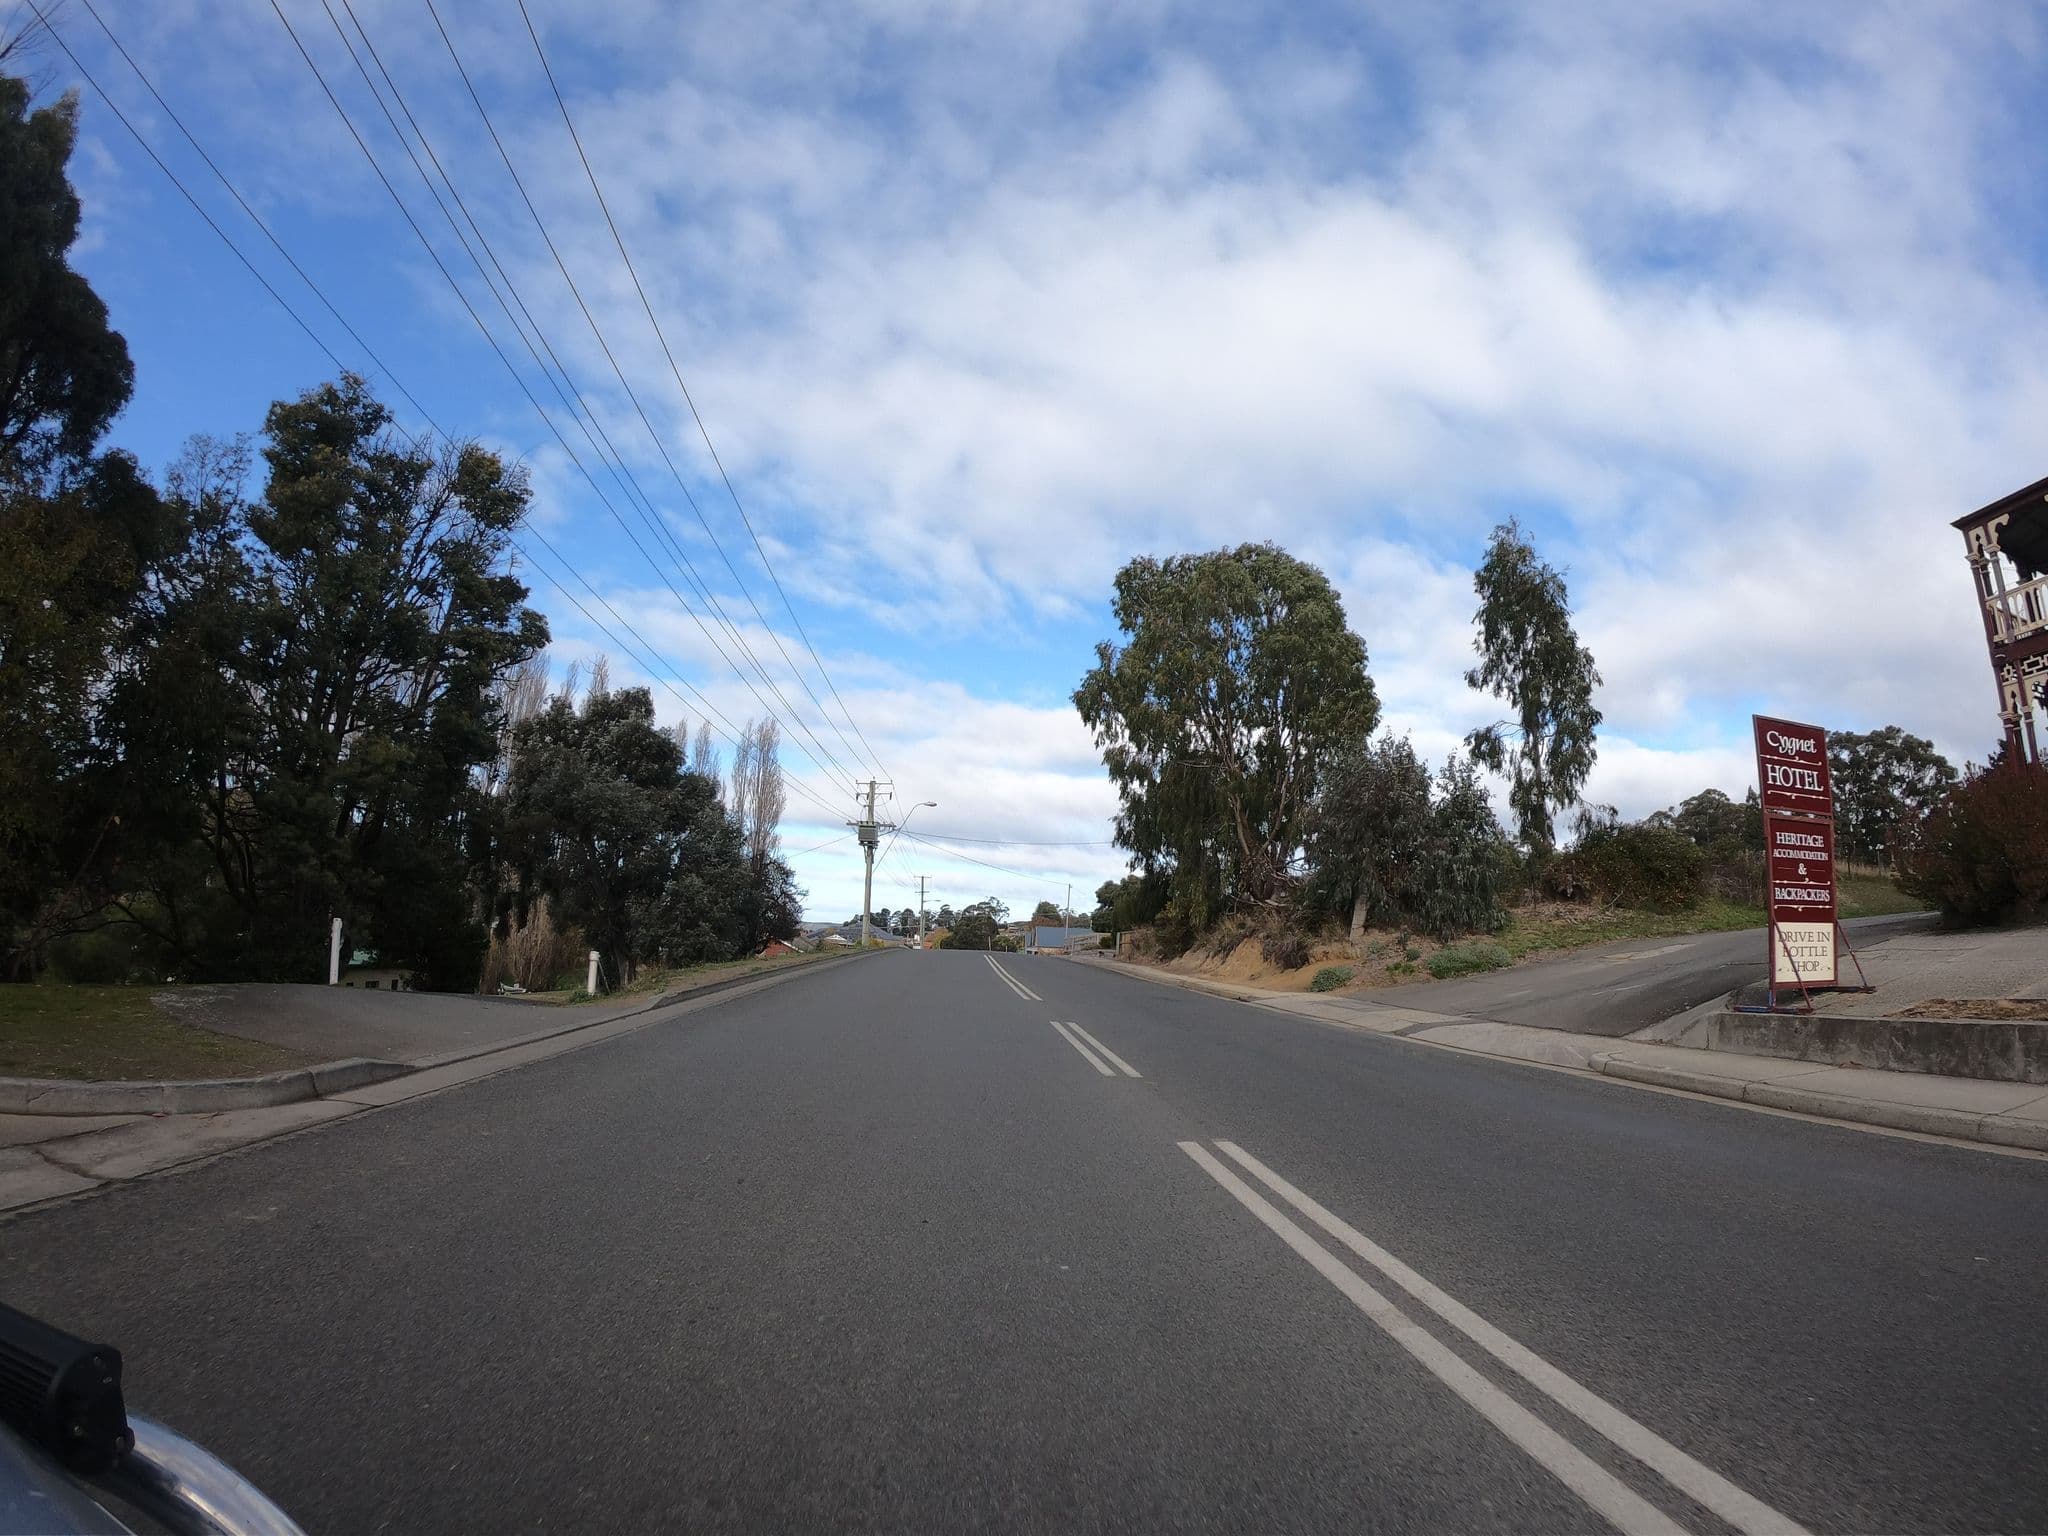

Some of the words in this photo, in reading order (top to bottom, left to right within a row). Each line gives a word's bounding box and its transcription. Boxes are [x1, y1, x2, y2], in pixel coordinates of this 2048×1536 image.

[1766, 730, 1817, 755] Cygnet
[1766, 764, 1824, 791] HOTEL
[1775, 832, 1824, 847] HERITAGE
[1773, 849, 1828, 860] ACCOMMODATION
[1798, 863, 1807, 875] &
[1774, 888, 1830, 902] BACKPACKERS
[1778, 931, 1813, 942] DRIVE
[1817, 931, 1831, 942] IN
[1791, 960, 1820, 972] HOP
